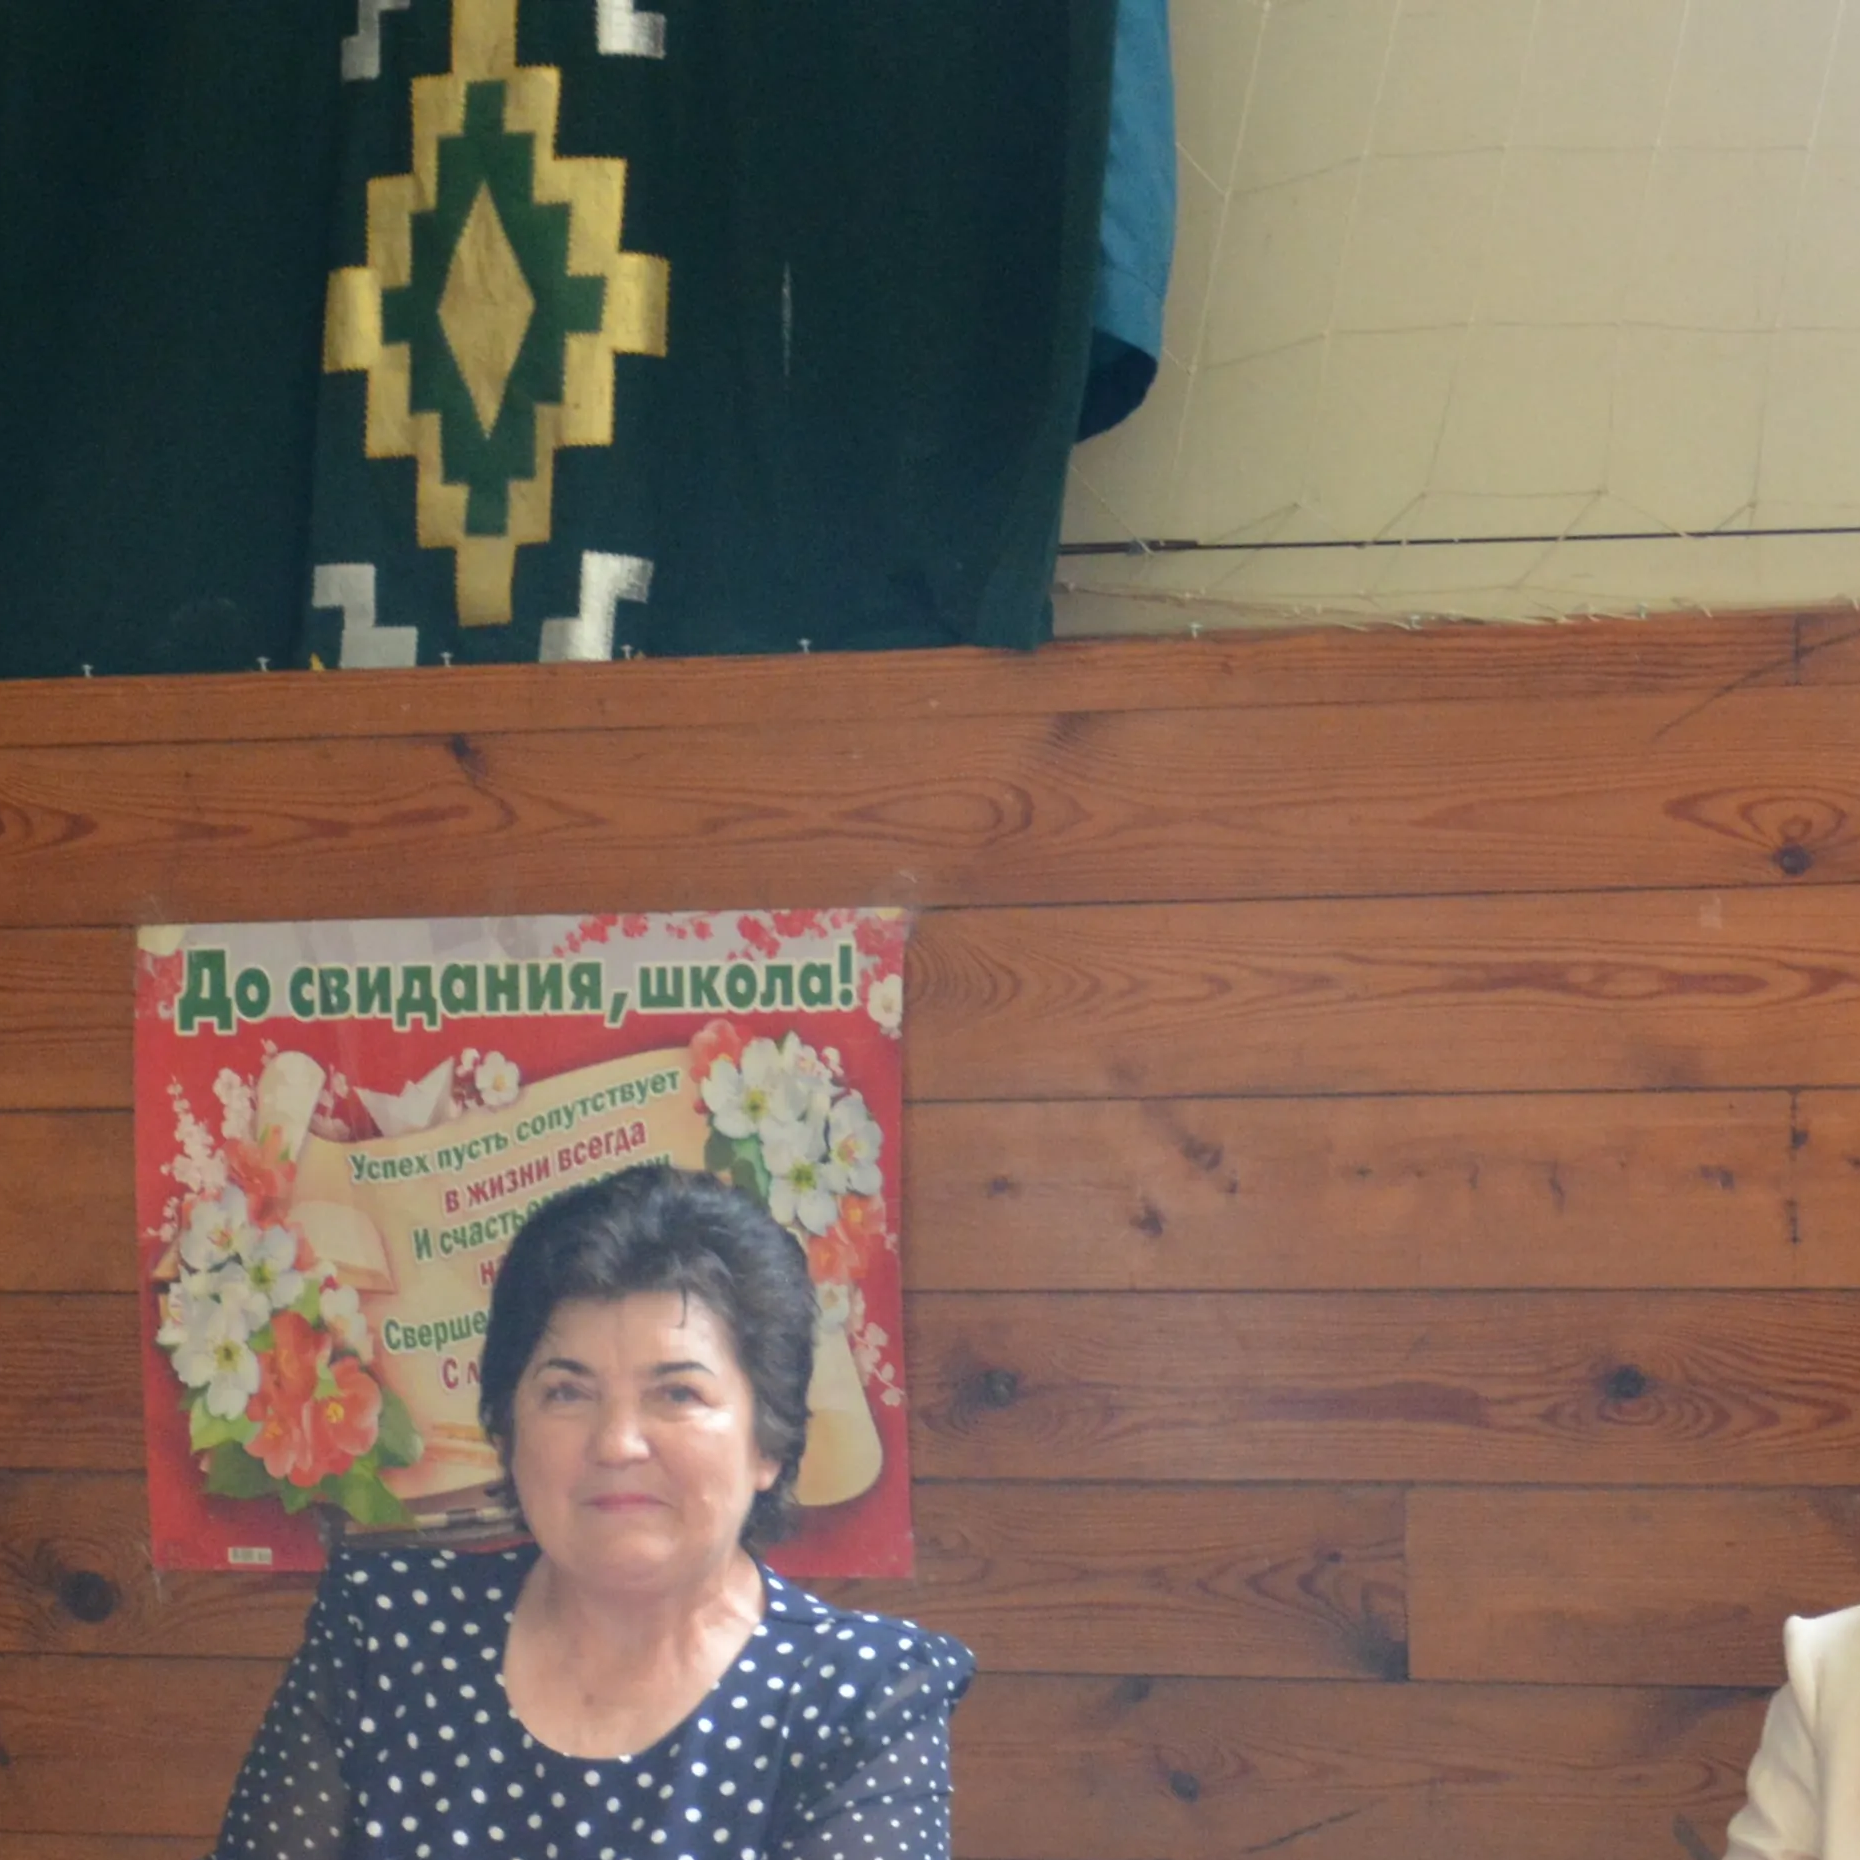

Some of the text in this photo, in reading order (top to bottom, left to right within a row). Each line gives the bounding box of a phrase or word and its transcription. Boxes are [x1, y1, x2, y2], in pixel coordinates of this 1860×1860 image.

[178, 943, 853, 1031] До свидания, школа!
[350, 1069, 680, 1181] Успех пусть сопутствует
[444, 1190, 460, 1214] в
[468, 1156, 551, 1208] жизни
[557, 1120, 647, 1175] всегда
[413, 1228, 434, 1261] И
